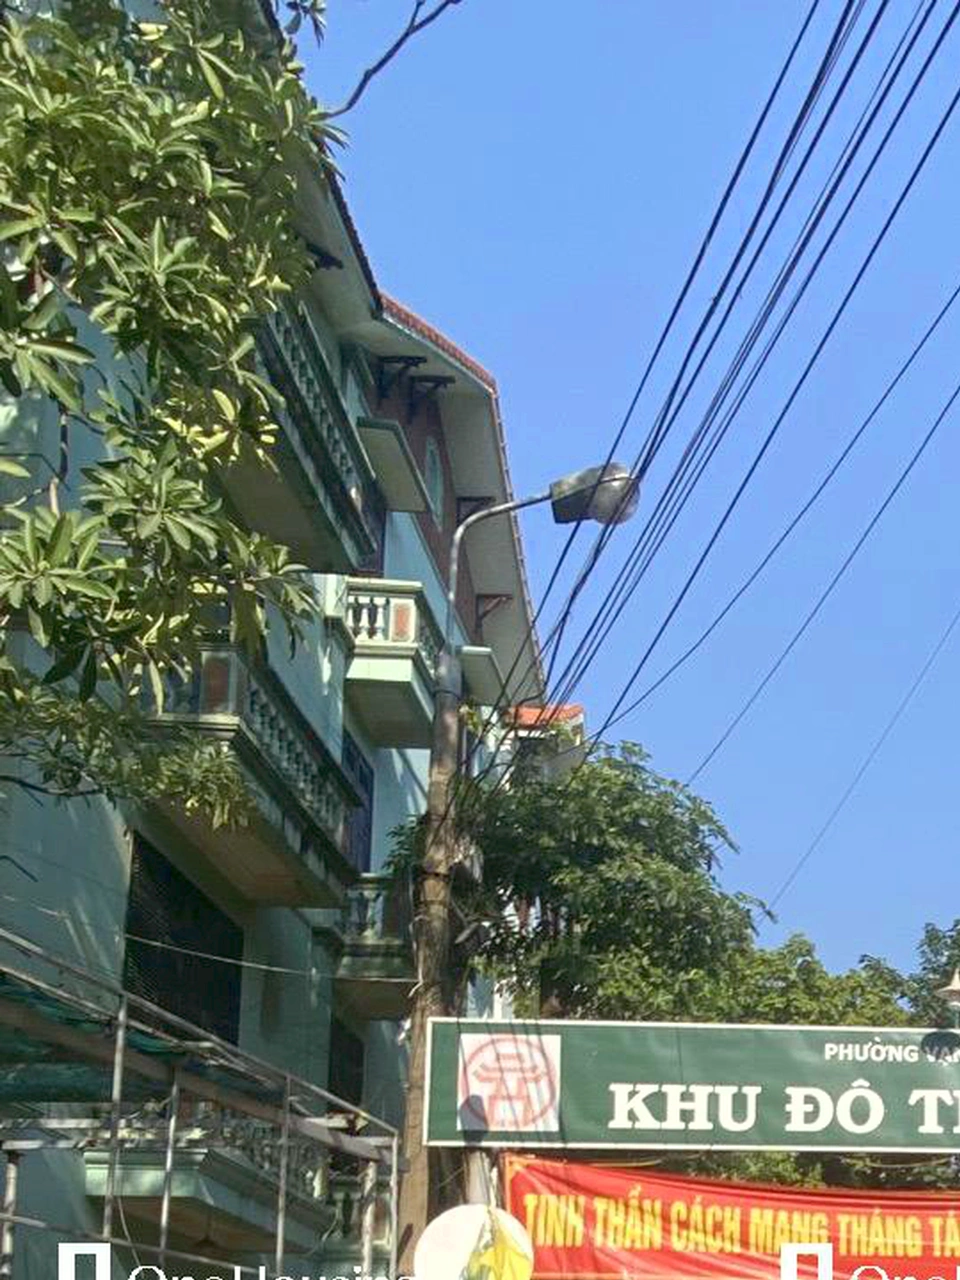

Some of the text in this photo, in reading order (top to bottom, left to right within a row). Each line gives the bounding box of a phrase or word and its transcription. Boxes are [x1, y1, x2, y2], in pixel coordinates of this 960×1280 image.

[825, 1036, 919, 1062] PHƯỜNG
[607, 1082, 762, 1132] KHU
[785, 1078, 885, 1134] ĐÔ
[524, 1193, 585, 1247] TINH
[670, 1195, 741, 1253] CÁCH
[837, 1207, 923, 1257] THÁNG
